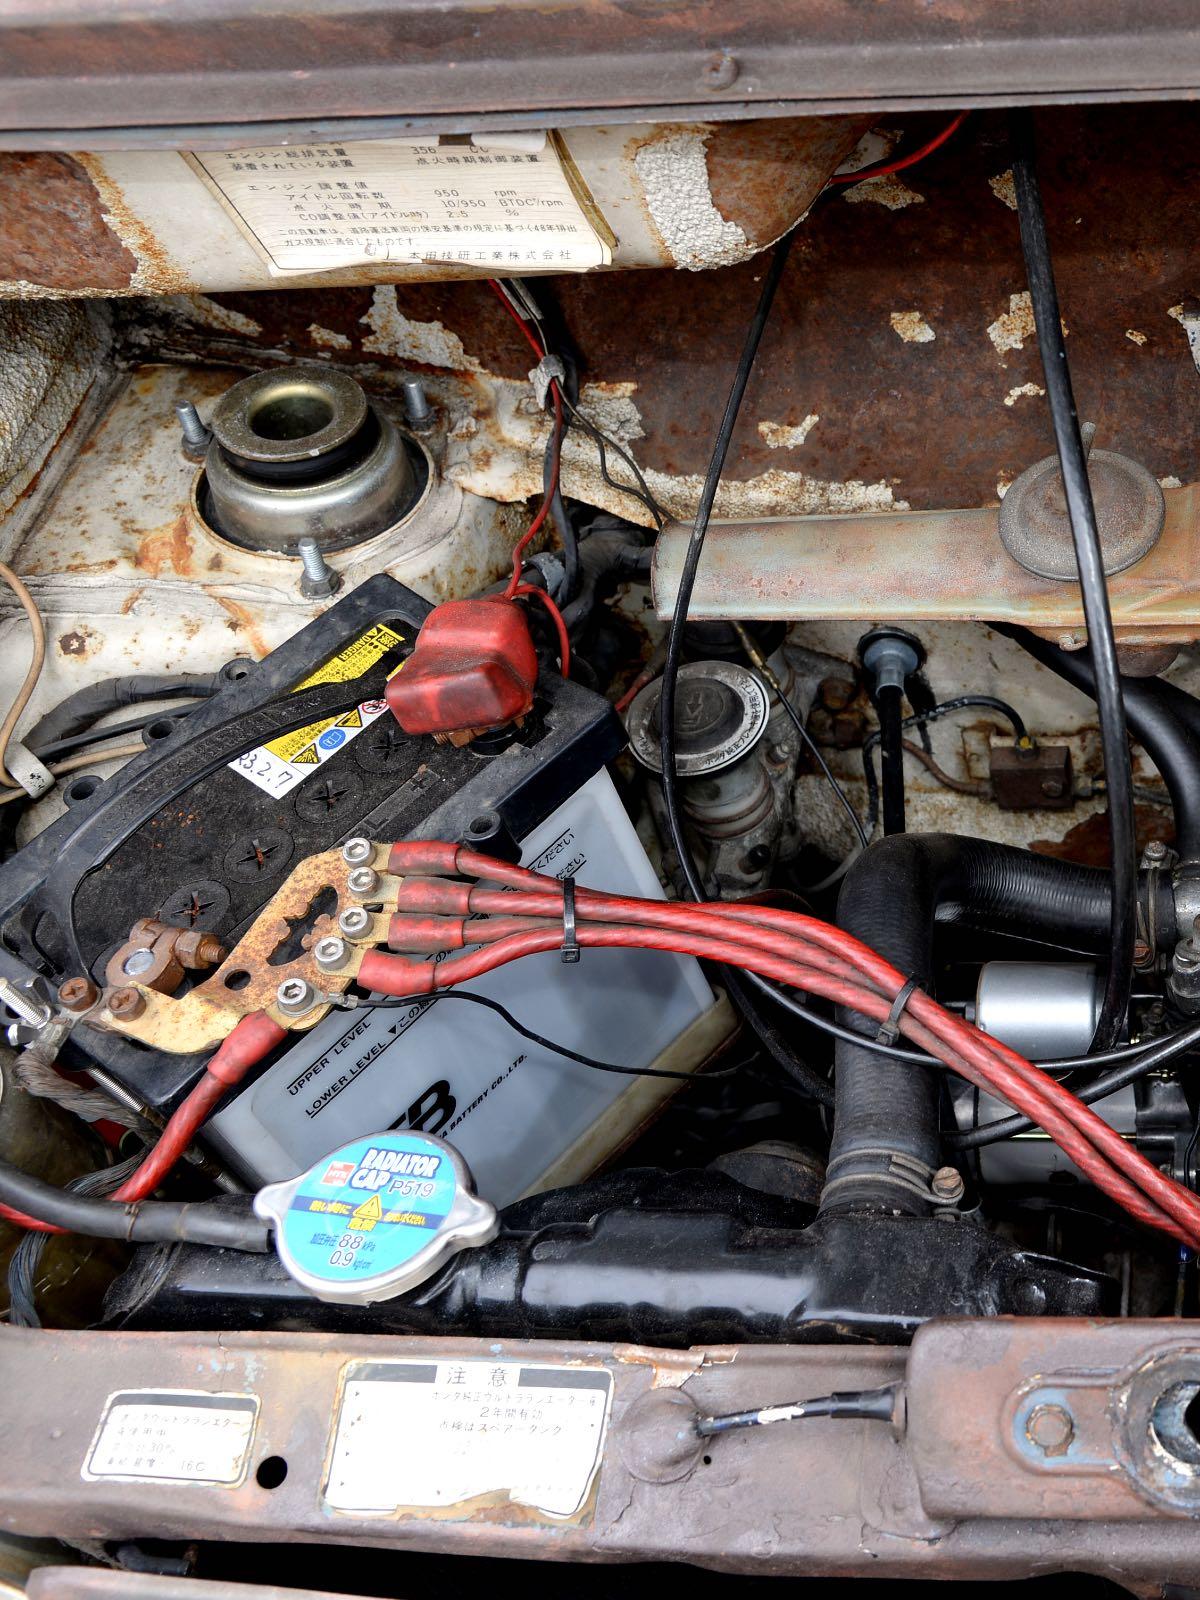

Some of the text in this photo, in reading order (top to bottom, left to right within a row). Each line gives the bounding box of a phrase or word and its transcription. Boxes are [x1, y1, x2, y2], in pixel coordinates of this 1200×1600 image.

[434, 189, 460, 198] 950
[494, 190, 517, 199] rpm
[339, 635, 372, 661] DANGER
[289, 1021, 371, 1096] UPPER LEVEL
[305, 1075, 348, 1116] LOWER
[349, 1042, 386, 1075] LEVEL
[450, 1089, 489, 1131] BATTERY
[359, 1148, 441, 1178] RADIATOR
[350, 1169, 391, 1191] CAP
[389, 1180, 434, 1198] P519
[338, 1234, 363, 1250] 88
[329, 1250, 354, 1267] 0.9
